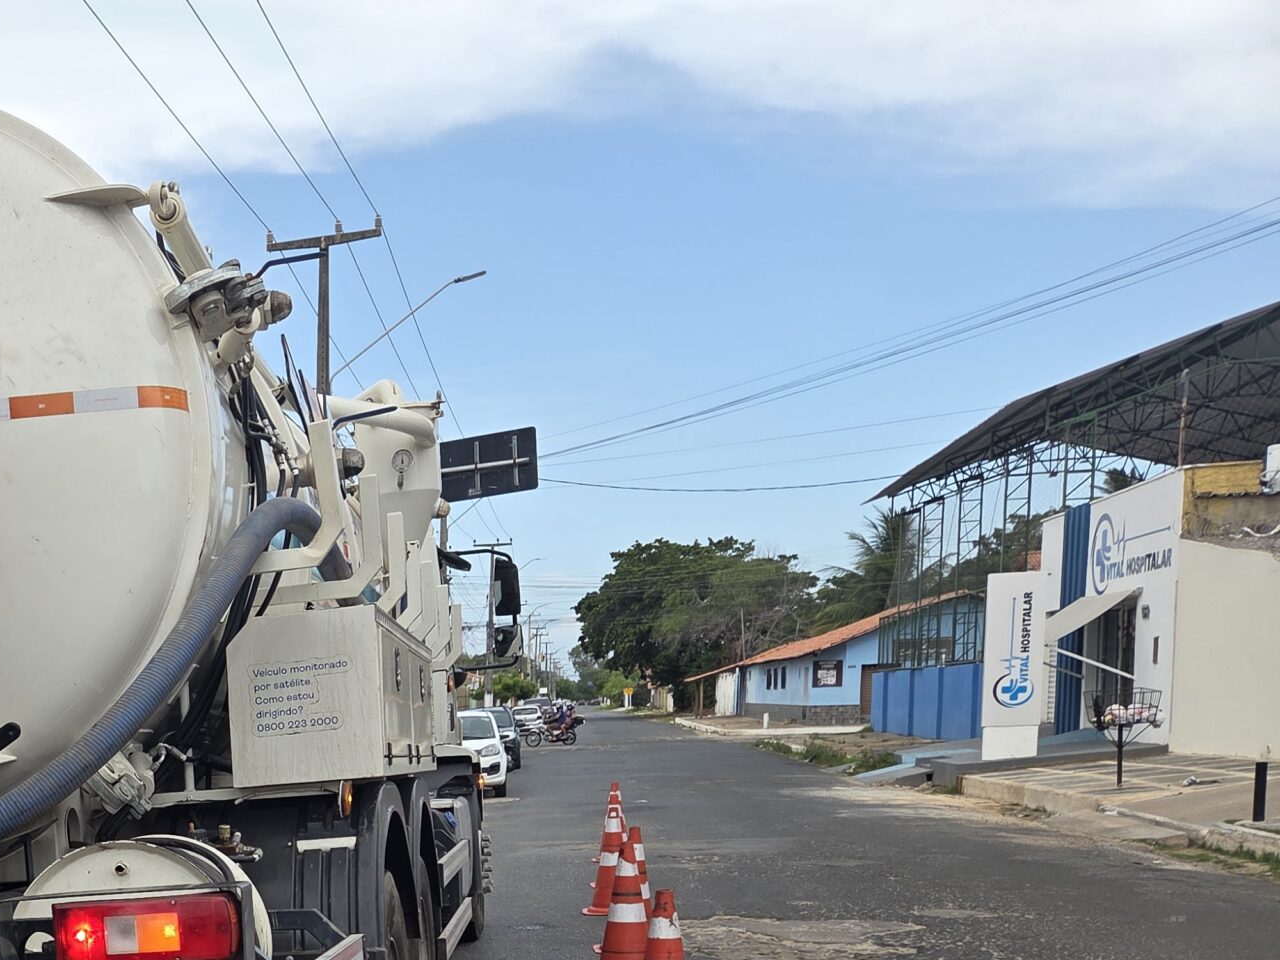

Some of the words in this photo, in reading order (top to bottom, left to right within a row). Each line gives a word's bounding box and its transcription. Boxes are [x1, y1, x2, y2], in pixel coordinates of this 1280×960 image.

[1106, 560, 1125, 581] VITAL
[1126, 547, 1173, 577] HOSPITALAR
[1020, 591, 1034, 653] HOSPITALAR
[252, 666, 288, 678] Veículo
[289, 659, 348, 675] monitorado
[1019, 655, 1030, 684] VITAL
[253, 683, 271, 693] por
[273, 678, 313, 690] satélite.
[254, 694, 284, 706] Como
[286, 691, 315, 702] estou
[255, 705, 304, 719] dirigindo?
[256, 721, 285, 733] 0800
[288, 718, 308, 730] 223
[310, 715, 339, 727] 2000
